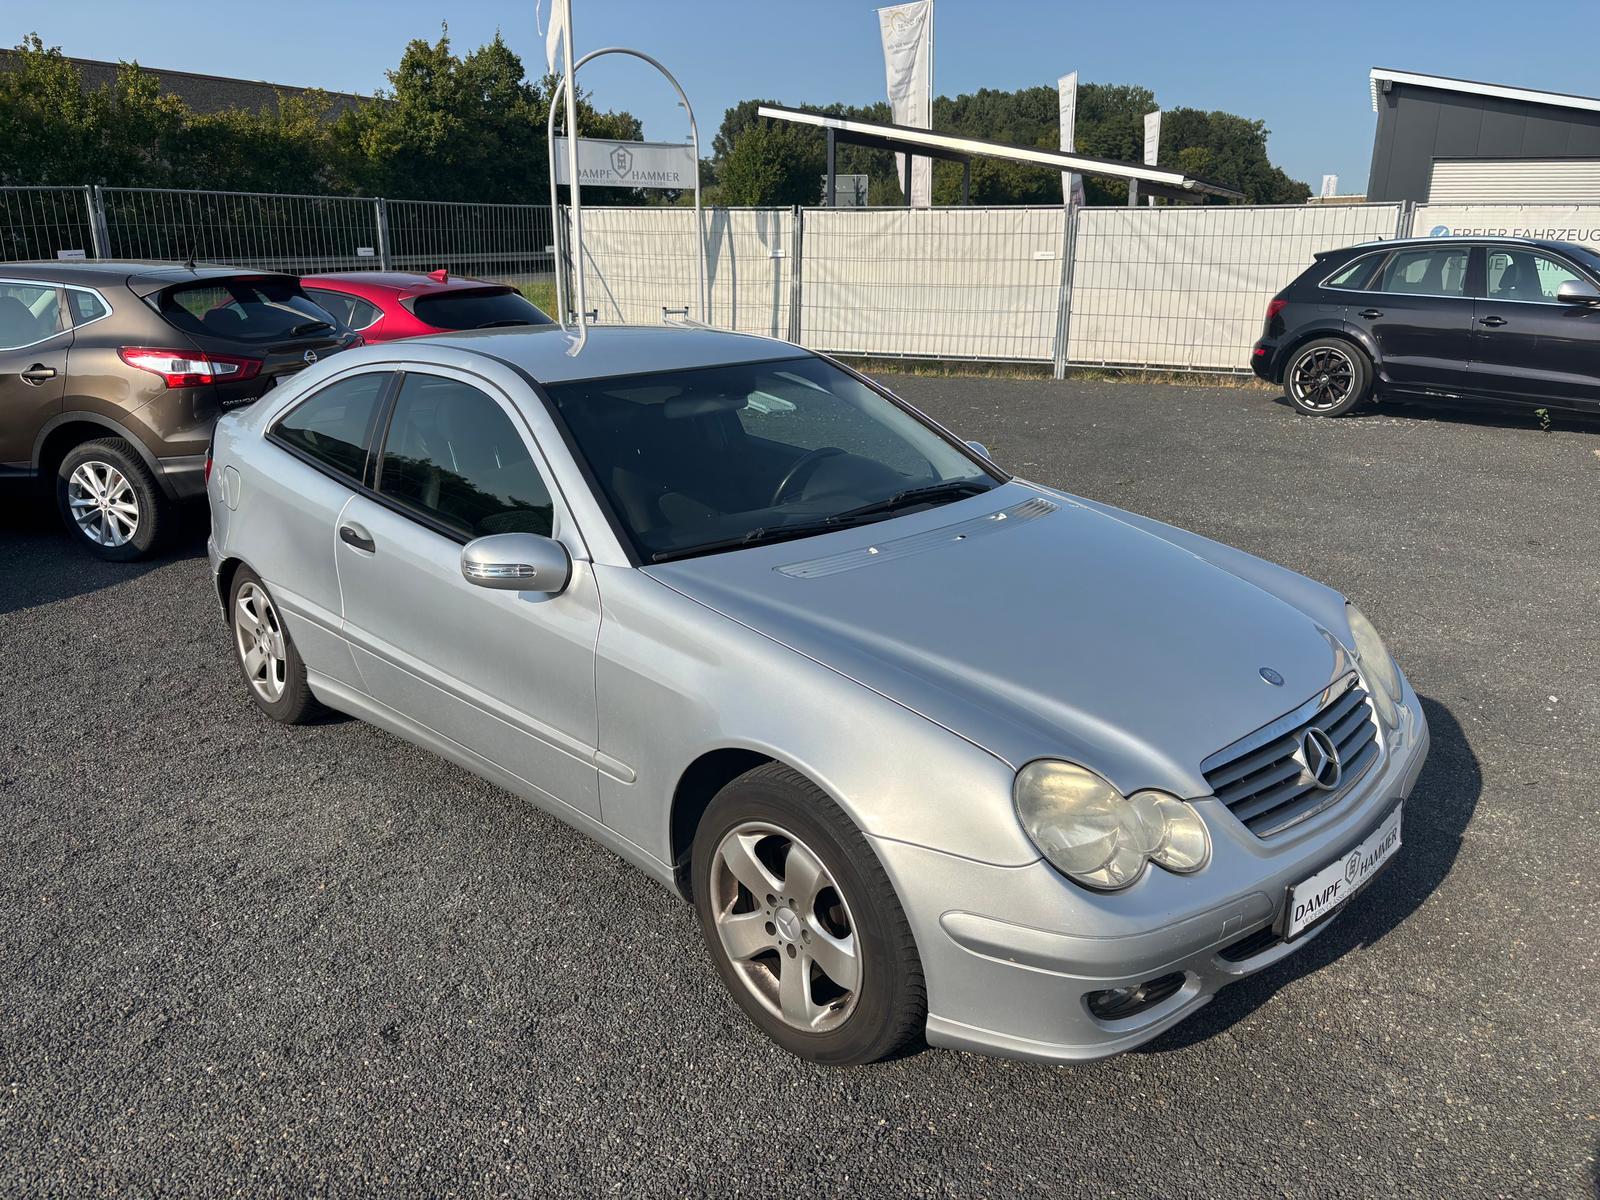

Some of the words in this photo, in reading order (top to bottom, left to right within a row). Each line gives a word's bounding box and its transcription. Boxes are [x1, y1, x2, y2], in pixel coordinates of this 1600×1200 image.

[632, 170, 680, 182] HAMMER
[1453, 228, 1508, 238] FREIER
[1294, 878, 1343, 922] DAMPF
[1359, 827, 1398, 877] HAMMER
